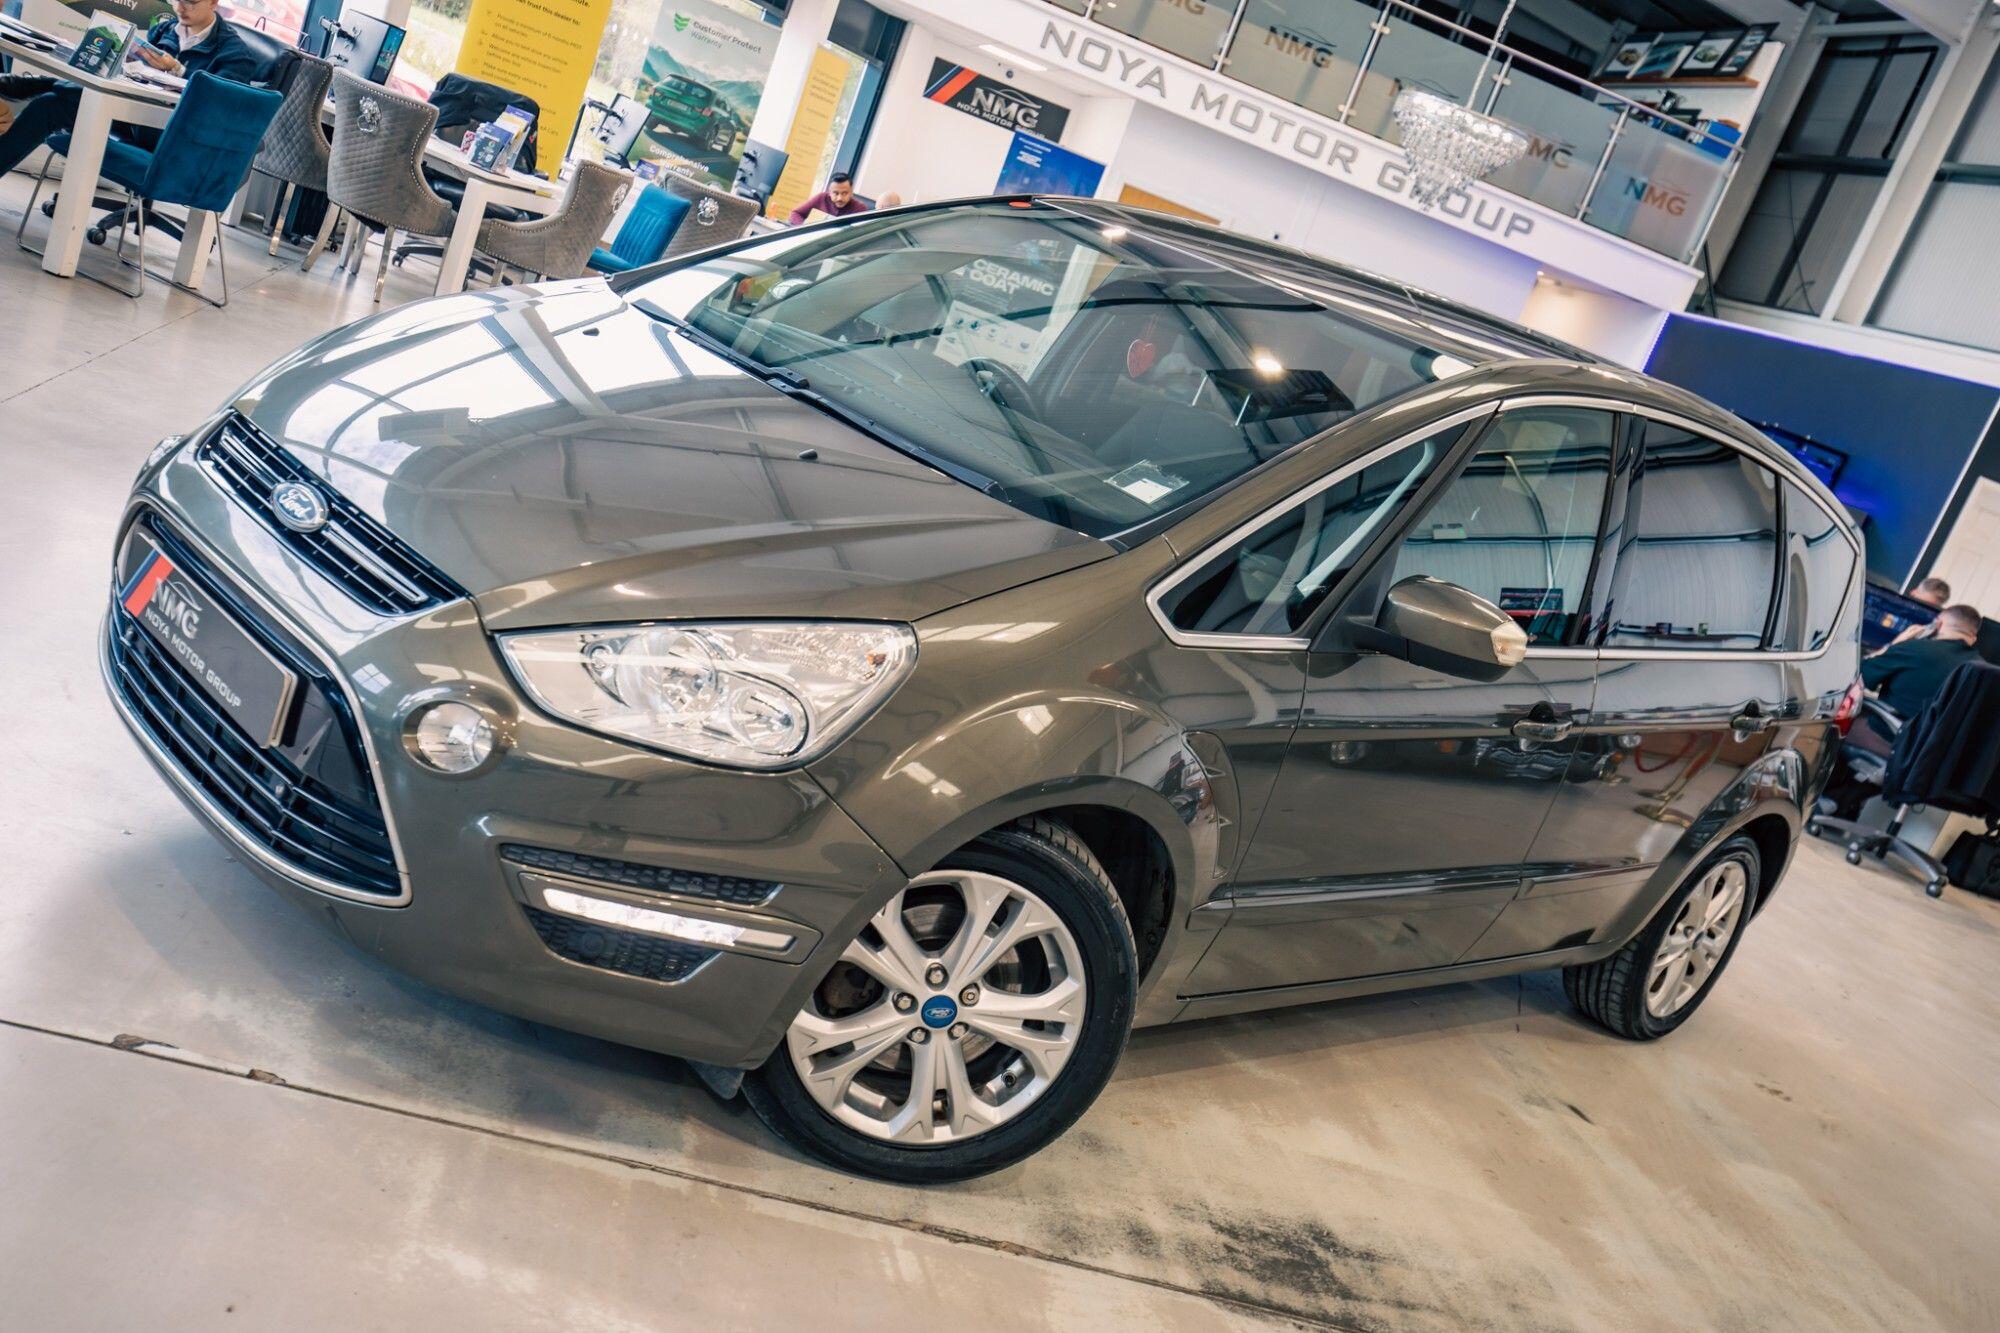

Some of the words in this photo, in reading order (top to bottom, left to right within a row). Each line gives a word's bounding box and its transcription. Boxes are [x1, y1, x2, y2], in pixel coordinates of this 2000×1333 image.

[693, 20, 732, 41] Customer
[732, 36, 762, 54] Protect
[1264, 25, 1334, 69] NMG
[956, 101, 980, 116] NOYA
[982, 111, 1014, 128] MOTOR
[971, 87, 1040, 129] NMG
[1040, 20, 1166, 99] NOYA
[1190, 83, 1359, 174] MOTOR
[1377, 161, 1534, 238] GOUP
[1625, 176, 1686, 216] NMG
[969, 268, 1020, 295] COAT
[972, 258, 1055, 297] CERAMIC
[151, 577, 200, 640] NMG
[145, 606, 170, 638] NOYA
[171, 633, 206, 675] MOTOR
[206, 668, 242, 707] GROUP
